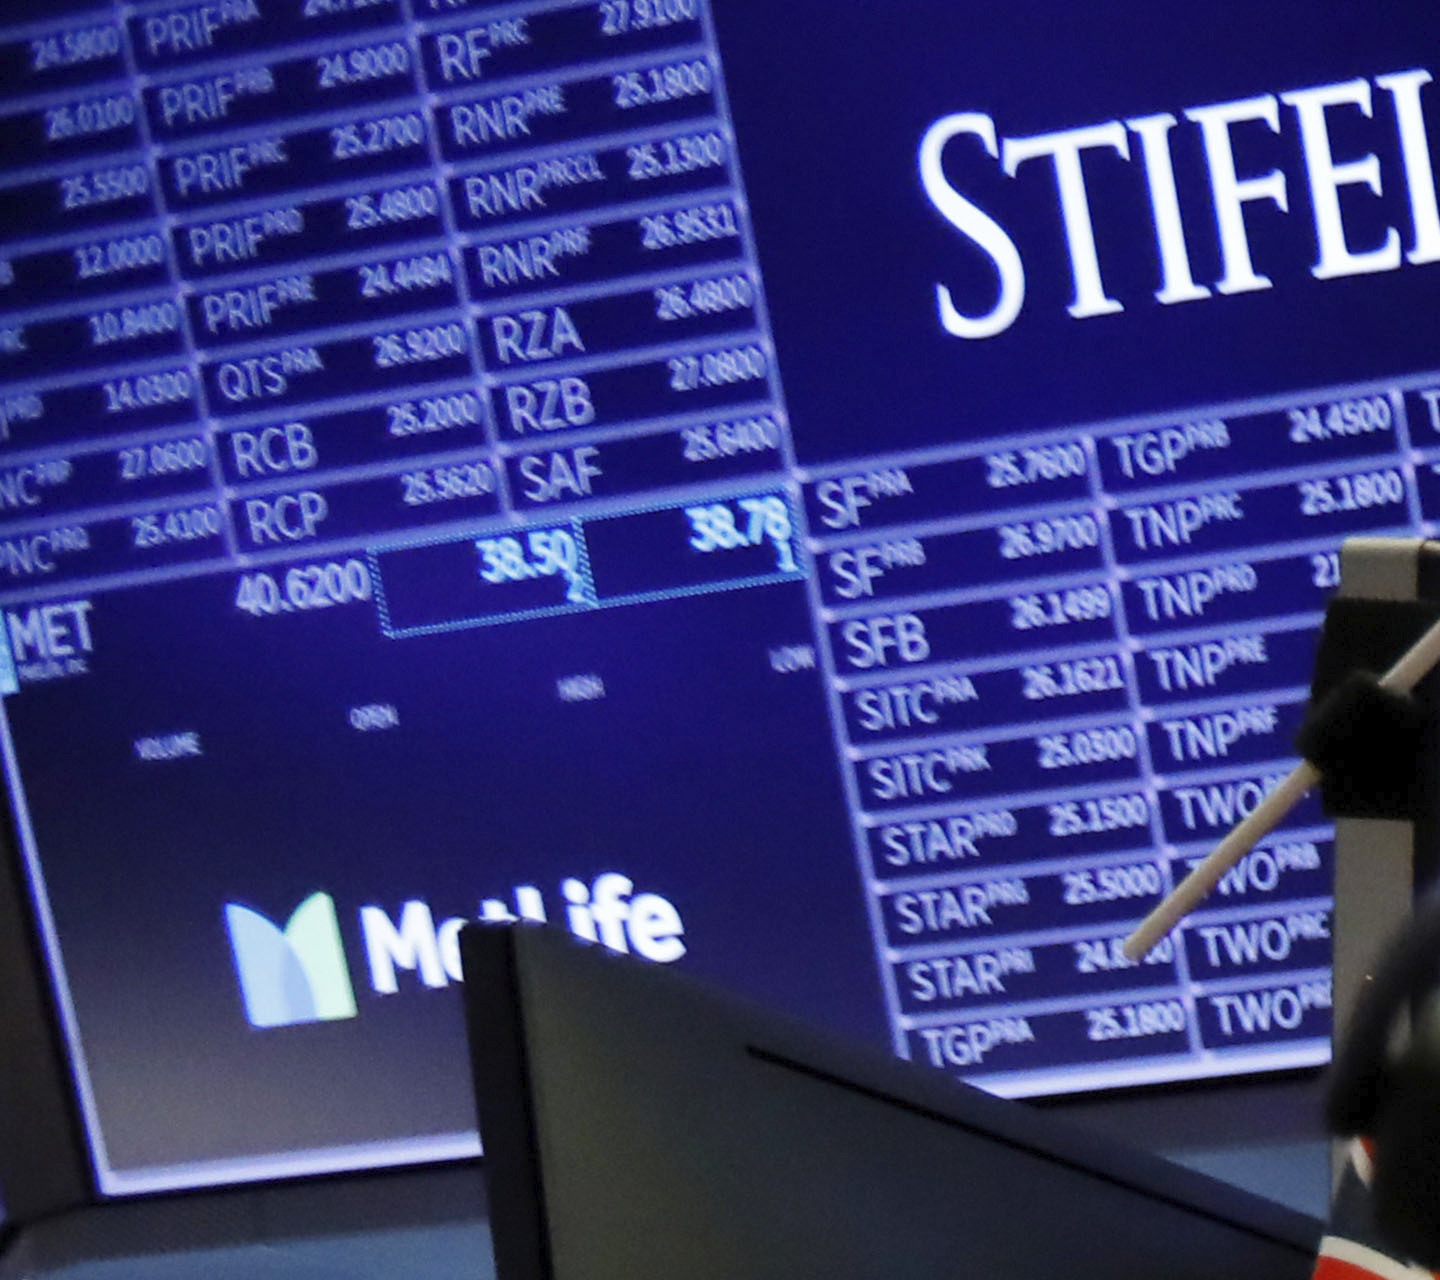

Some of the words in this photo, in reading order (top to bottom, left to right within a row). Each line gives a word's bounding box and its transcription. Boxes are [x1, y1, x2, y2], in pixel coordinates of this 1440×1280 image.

[491, 306, 586, 364] RZA
[505, 376, 597, 435] RZB
[232, 421, 320, 478] RCB
[518, 445, 603, 504] SAF
[246, 491, 329, 544] RCP
[235, 558, 373, 617] 40.6200
[5, 600, 94, 662] MET
[841, 612, 931, 669] SFB
